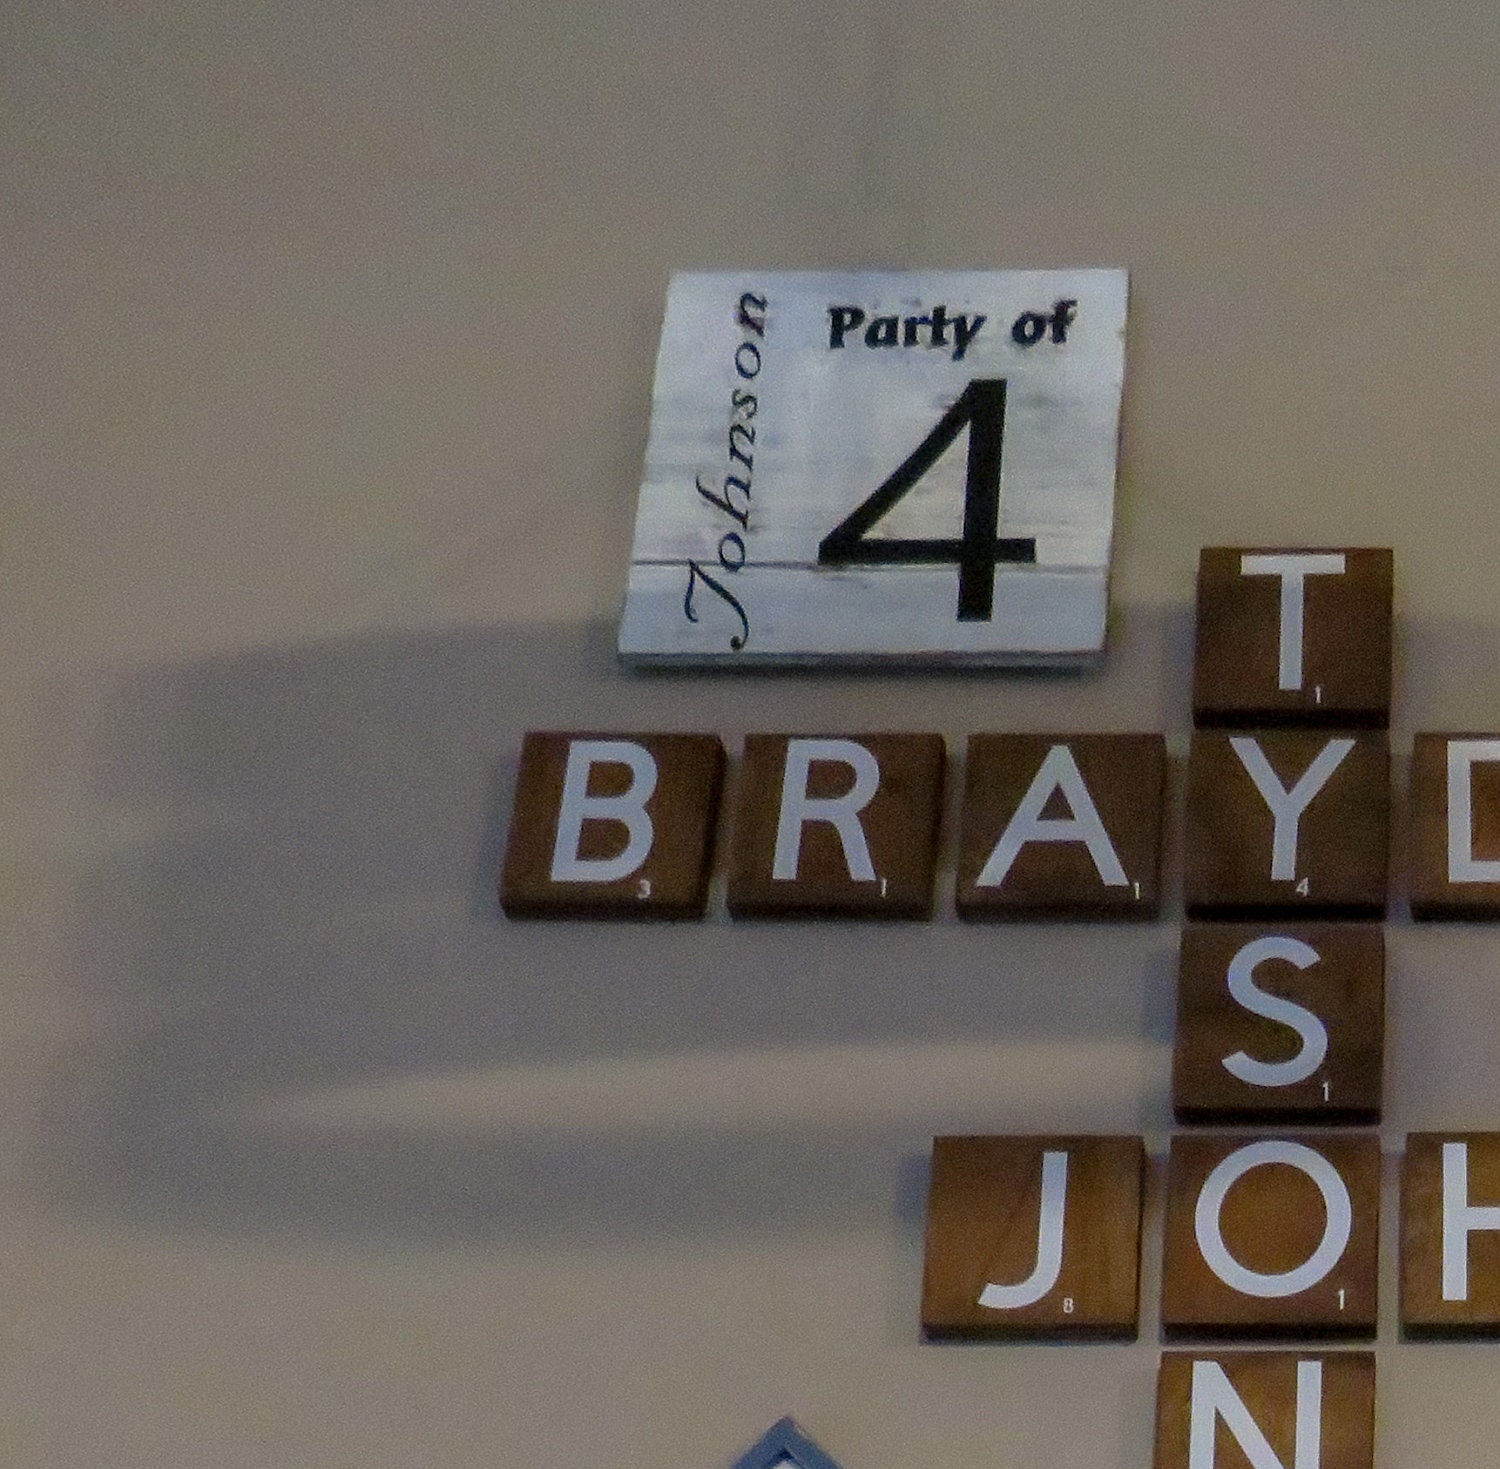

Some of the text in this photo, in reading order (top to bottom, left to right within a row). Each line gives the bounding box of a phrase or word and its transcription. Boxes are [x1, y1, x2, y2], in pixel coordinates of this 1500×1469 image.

[826, 299, 1078, 361] Party of
[683, 290, 768, 651] Johnson
[817, 377, 1037, 623] 4
[638, 879, 651, 899] 3
[1295, 877, 1309, 896] 4
